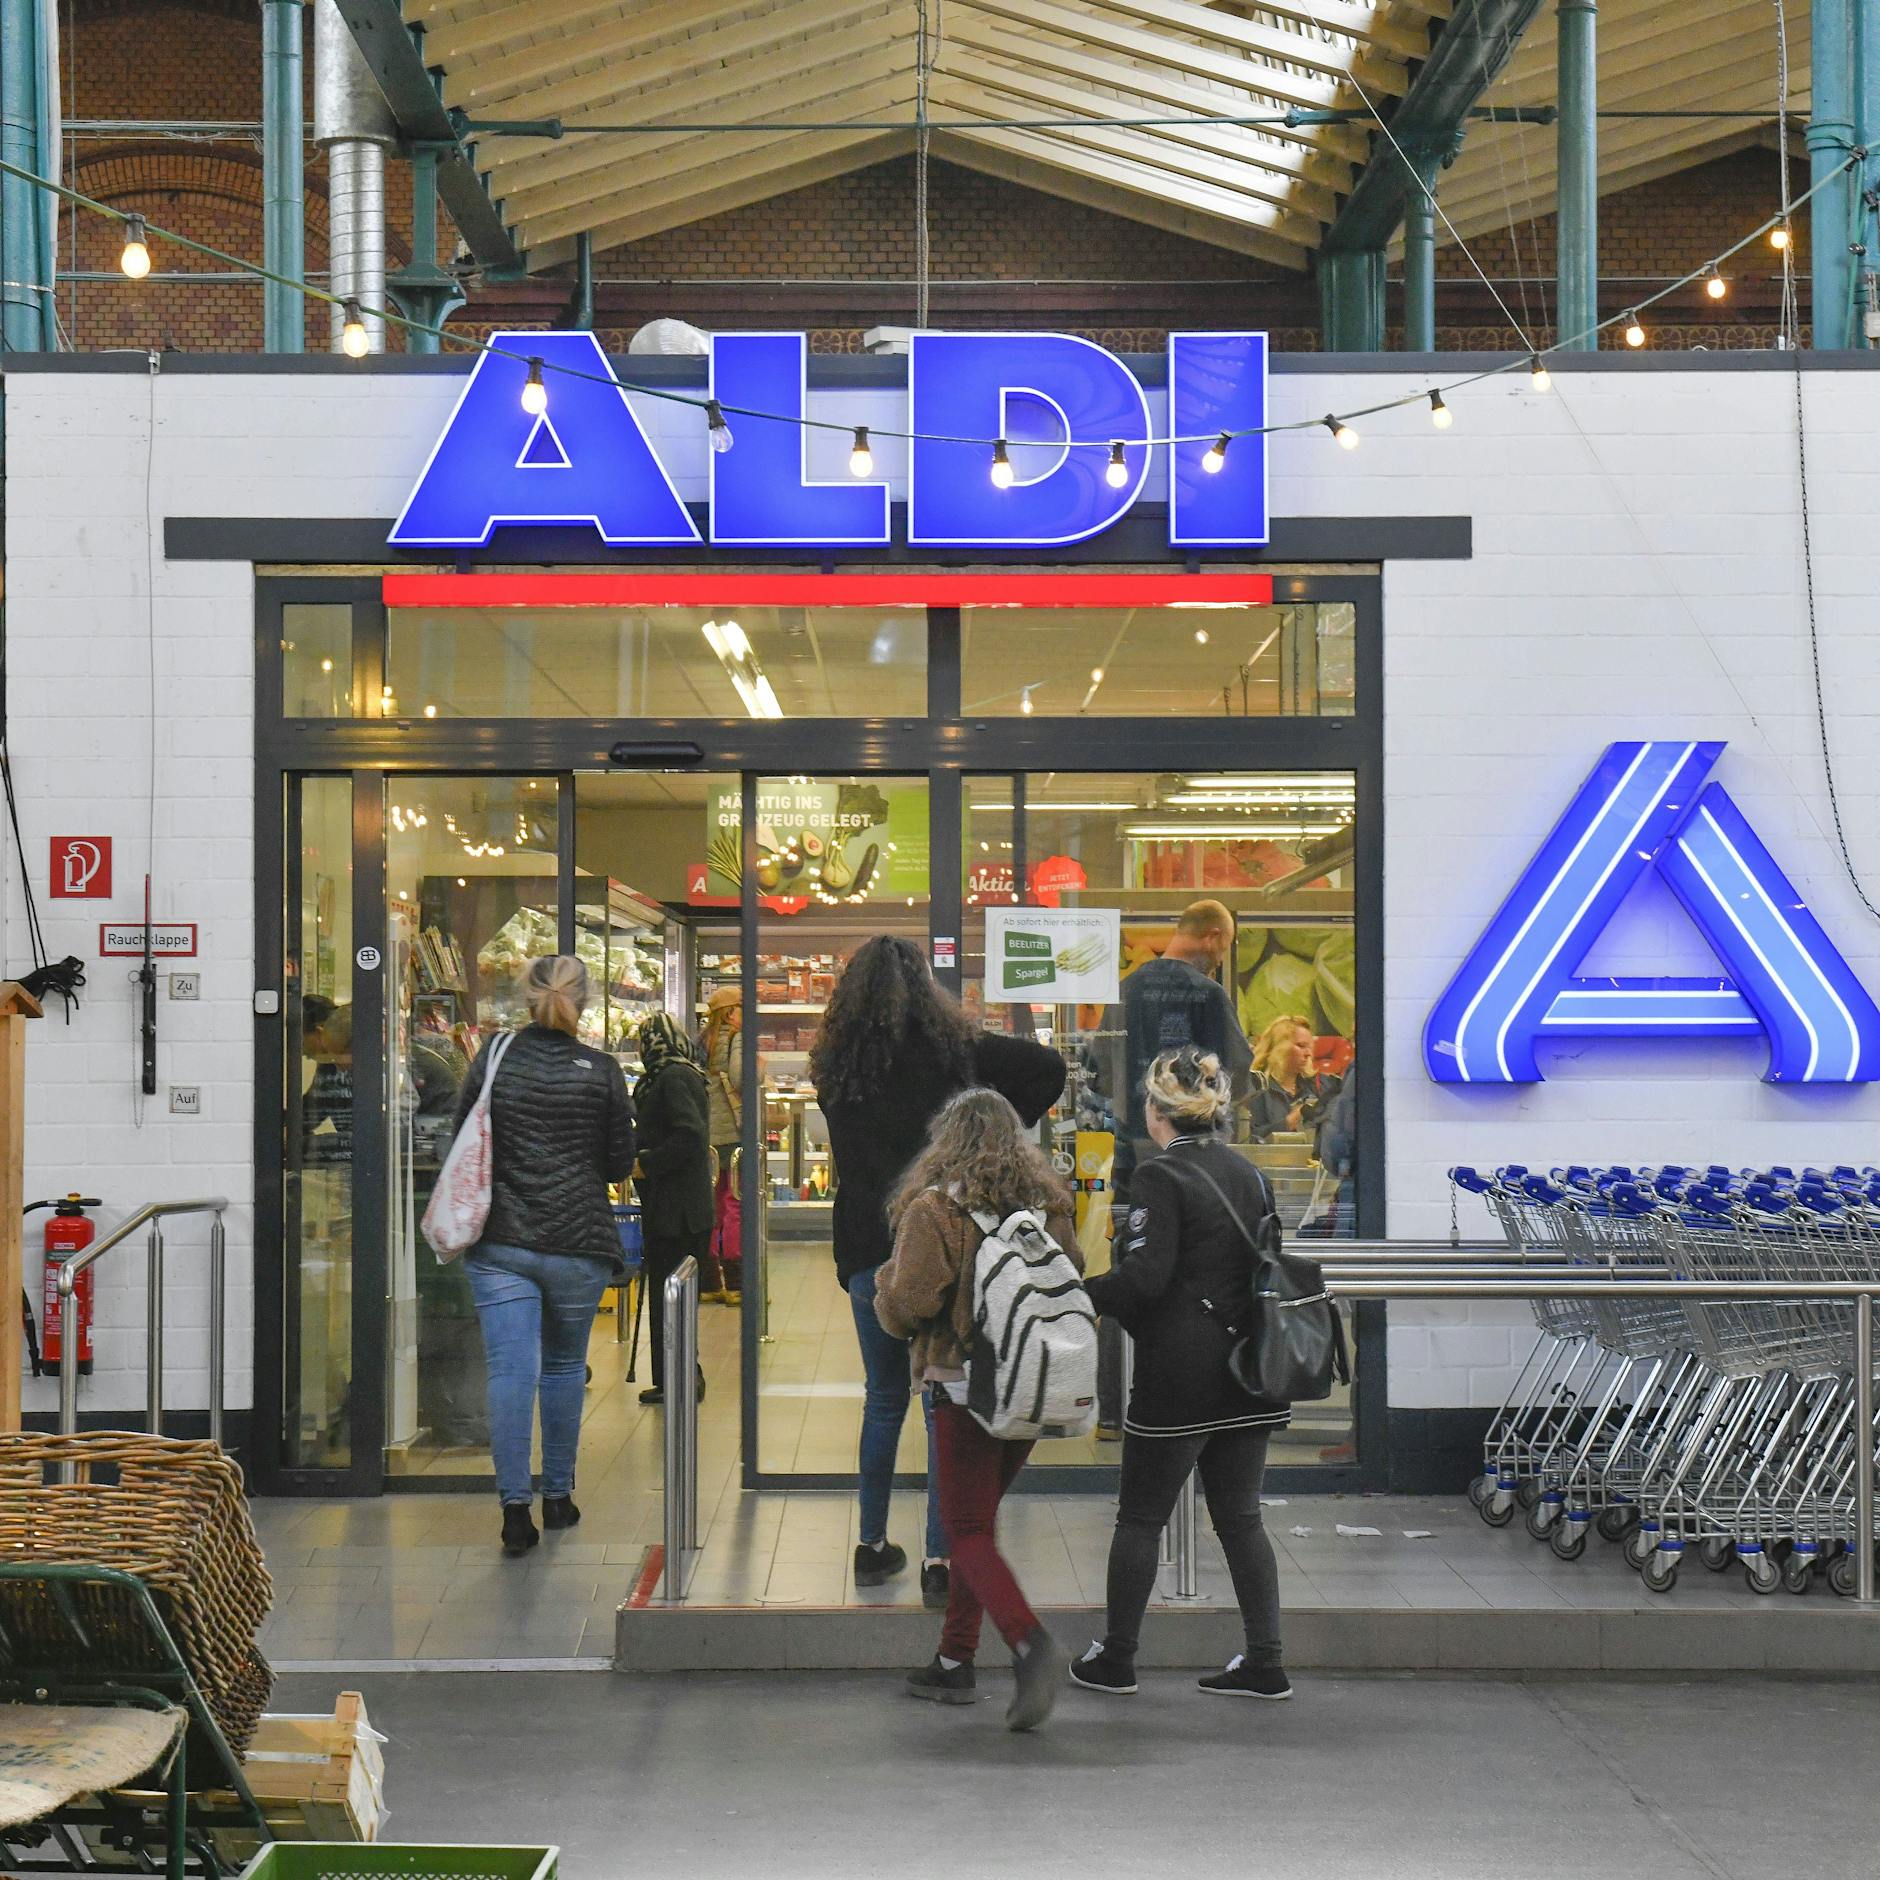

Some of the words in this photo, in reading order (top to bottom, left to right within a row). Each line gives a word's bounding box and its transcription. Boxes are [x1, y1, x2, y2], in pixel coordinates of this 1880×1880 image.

[387, 331, 1270, 547] ALDI
[718, 792, 791, 809] MÄHTIG
[795, 795, 823, 809] INS
[718, 813, 805, 827] GRNZEUG
[809, 813, 874, 827] GELEGT.
[1003, 917, 1015, 926] Ab
[1017, 917, 1041, 926] sofort
[1043, 918, 1059, 926] hier
[1008, 939, 1050, 949] BEELITZER
[1015, 967, 1049, 980] Spargel
[176, 979, 193, 991] Zu
[175, 1092, 196, 1104] Auf
